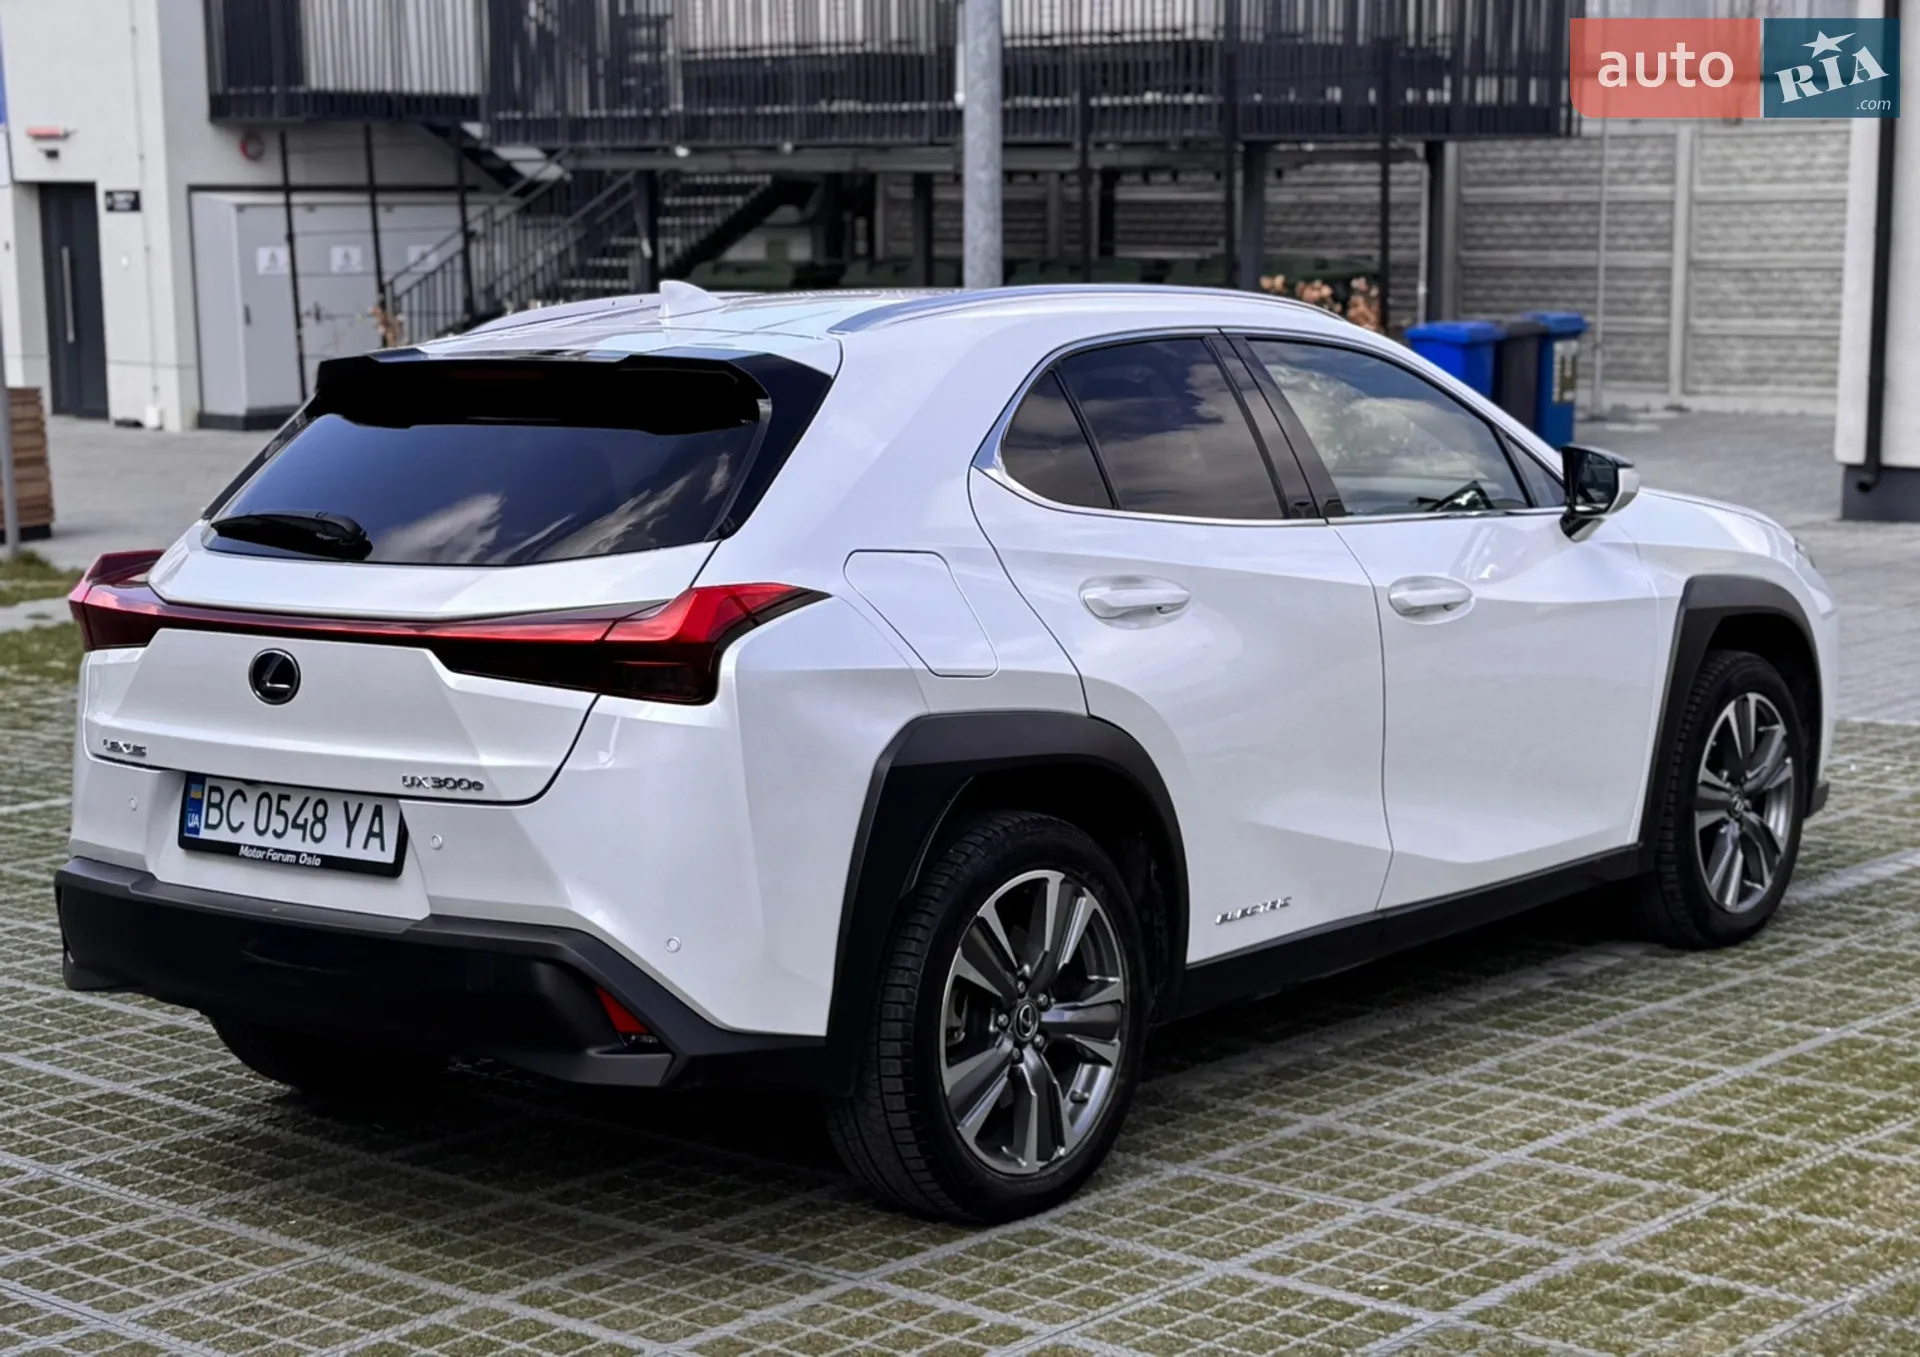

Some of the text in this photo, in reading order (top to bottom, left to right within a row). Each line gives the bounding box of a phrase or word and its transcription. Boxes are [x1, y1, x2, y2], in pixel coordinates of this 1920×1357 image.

[187, 812, 200, 828] UA
[204, 785, 386, 852] BC 0548 YA
[299, 853, 321, 866] Oslo
